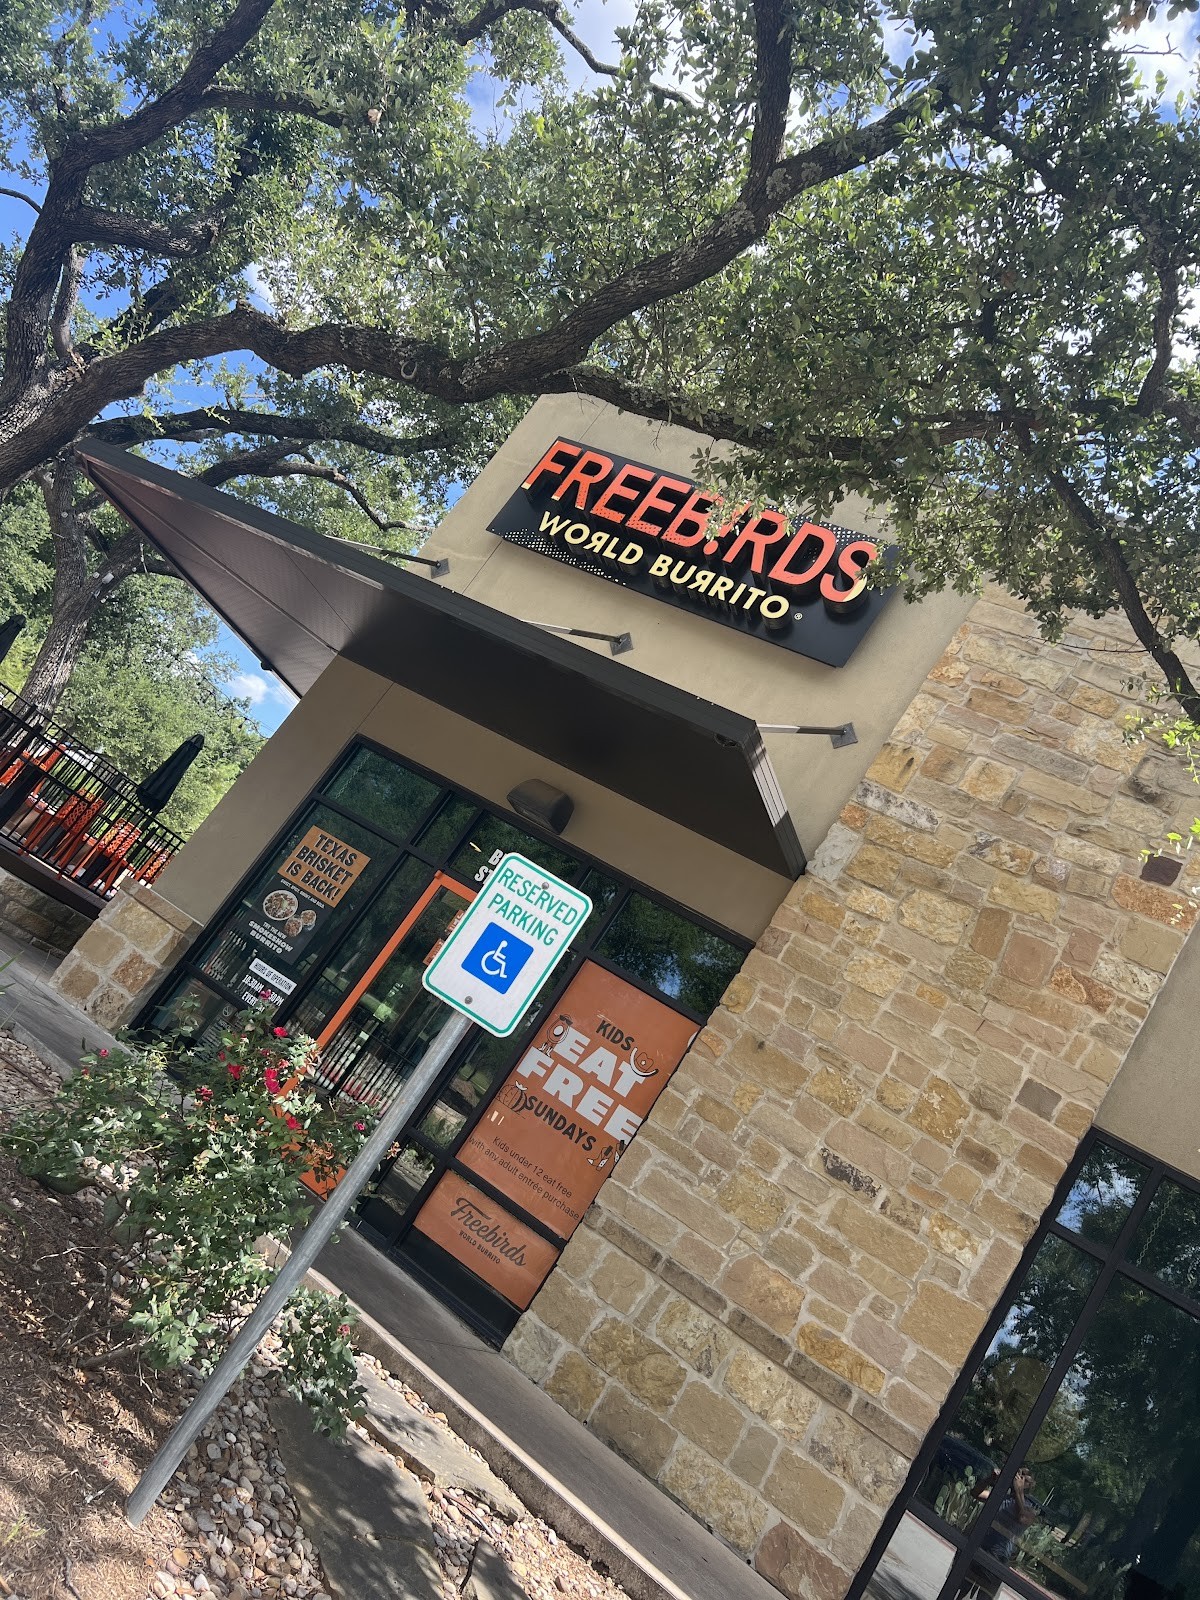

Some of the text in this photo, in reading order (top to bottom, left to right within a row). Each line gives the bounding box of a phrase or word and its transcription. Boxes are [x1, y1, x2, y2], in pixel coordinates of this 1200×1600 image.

[648, 554, 789, 619] BURRITO
[296, 845, 353, 885] BRISKET
[314, 834, 358, 867] TEXAS
[285, 861, 302, 877] IS
[300, 870, 341, 901] BACK!
[497, 867, 579, 926] RESERVED
[249, 920, 294, 952] SMOKESHOW
[250, 930, 282, 954] BURRITO
[487, 892, 559, 946] PARKING
[553, 1027, 646, 1097] EAT
[595, 1019, 635, 1051] KIDS
[516, 1046, 643, 1141] FREE
[523, 1095, 597, 1152] SUNDAYS
[468, 1136, 580, 1220] with any adult entrée purchase
[493, 1136, 573, 1199] Kids under 12 eat free
[450, 1197, 527, 1266] Freebirds
[459, 1229, 501, 1264] WORLD BURRITO
